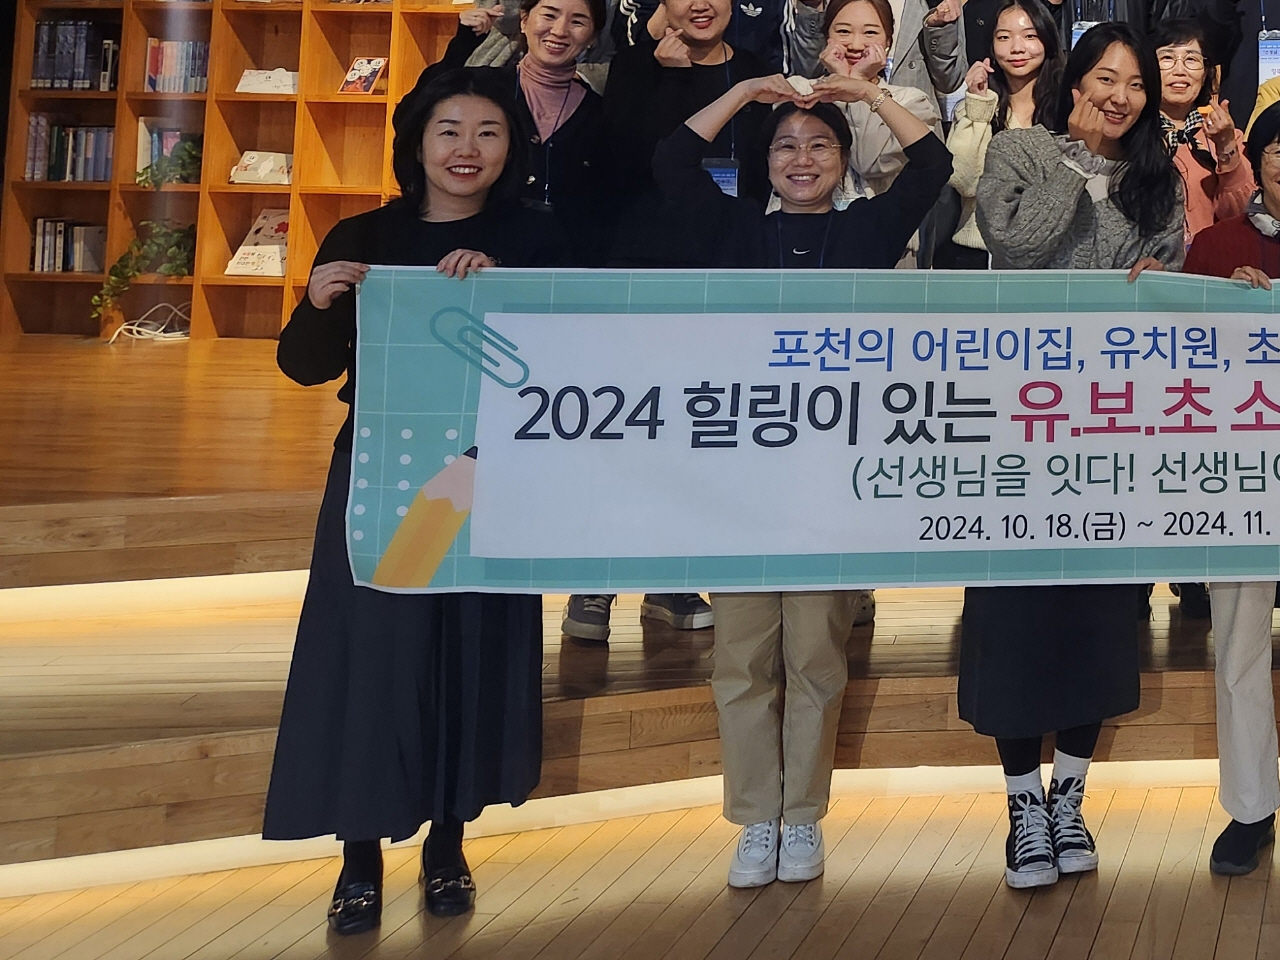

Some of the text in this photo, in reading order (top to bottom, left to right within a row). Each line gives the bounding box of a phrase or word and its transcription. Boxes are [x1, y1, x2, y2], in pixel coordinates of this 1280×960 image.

[768, 327, 894, 373] 포천의
[912, 326, 1085, 374] 어린이집,
[1100, 325, 1231, 373] 유치원,
[513, 385, 666, 441] 2024
[683, 380, 861, 449] 힐링이
[881, 380, 998, 446] 있는
[1010, 377, 1218, 443] 유.보.초
[851, 453, 1031, 501] (선생님을
[1046, 452, 1135, 497] 잇다!
[918, 515, 991, 541] 2024.
[1001, 514, 1035, 540] 10.
[1163, 510, 1234, 537] 2024.
[1243, 510, 1271, 536] 11.
